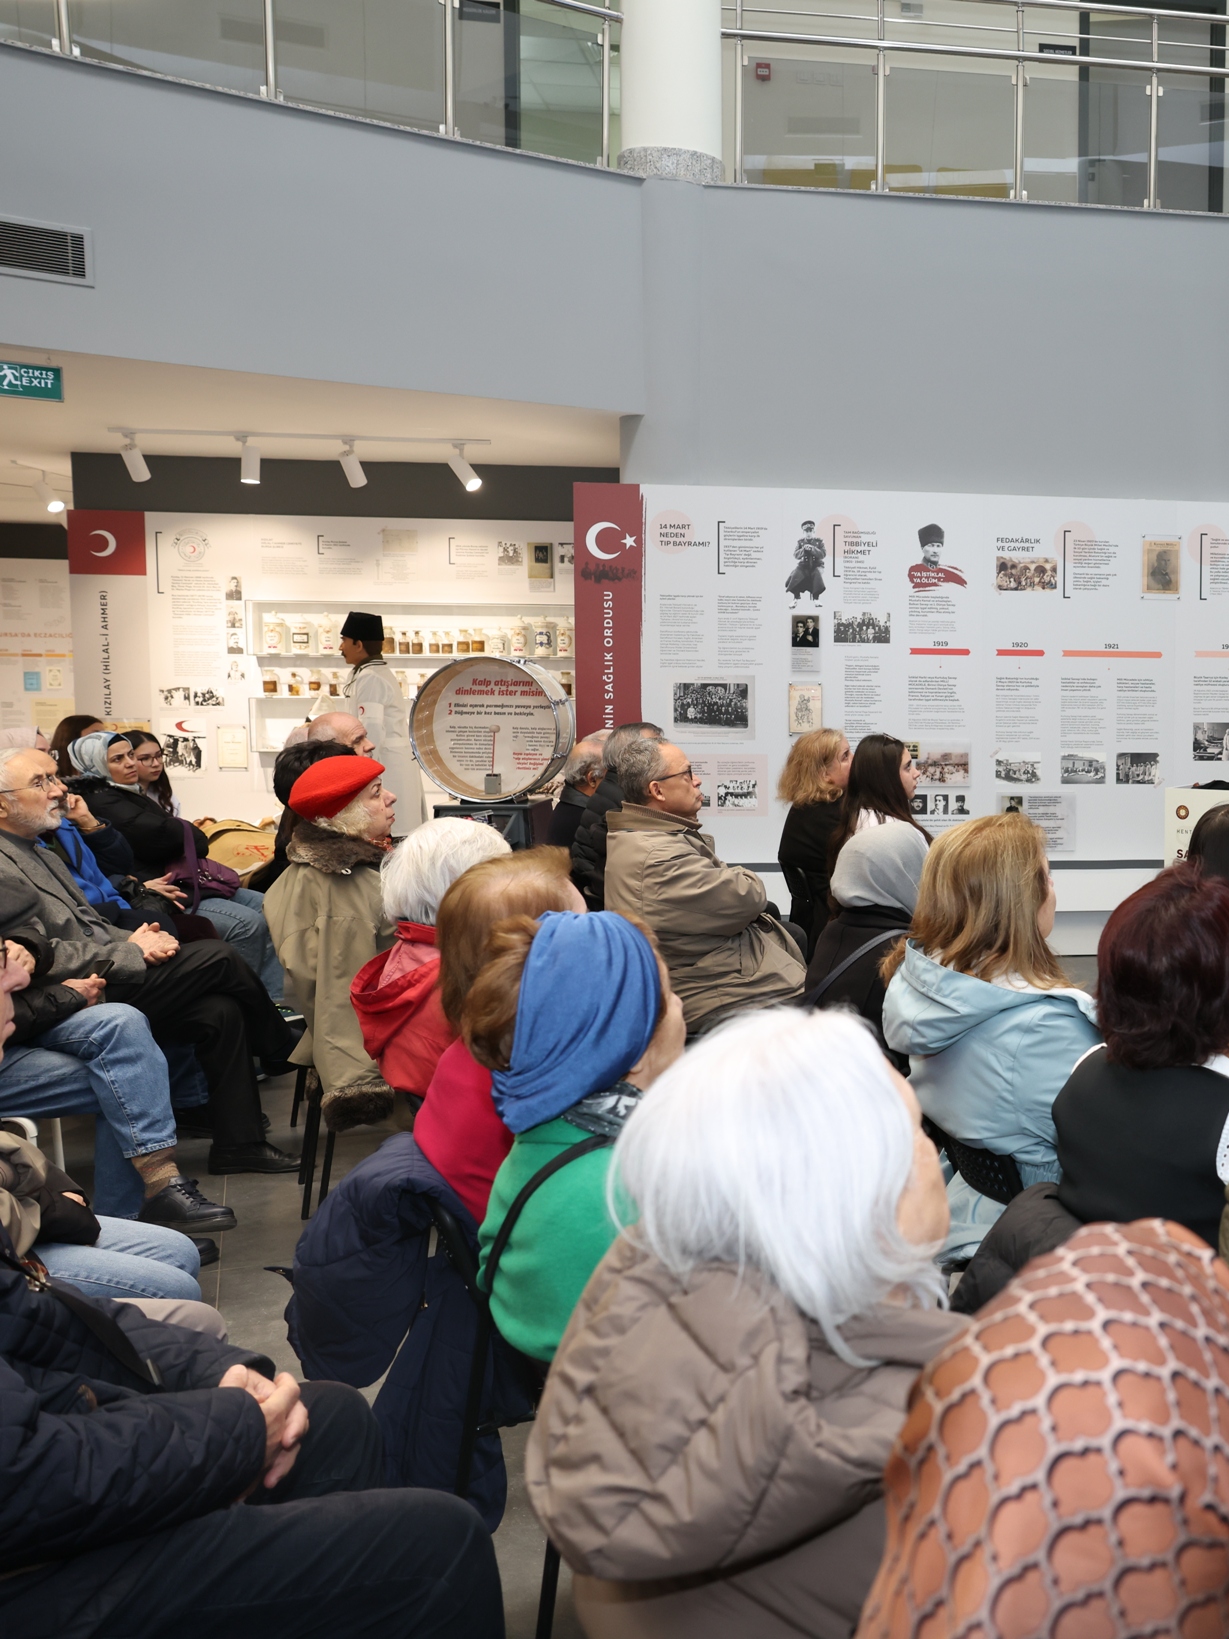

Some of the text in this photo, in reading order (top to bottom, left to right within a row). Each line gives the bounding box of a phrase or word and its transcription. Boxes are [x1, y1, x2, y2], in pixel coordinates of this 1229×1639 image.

[20, 368, 54, 380] ÇIKIŞ
[22, 377, 54, 388] EXIT
[98, 590, 109, 631] AHMER)
[603, 591, 614, 732] NİN SAĞLIK ORDUSU
[472, 678, 534, 688] Kalp atışlarını
[104, 678, 112, 716] KIZILAY
[455, 687, 495, 696] dinlemek
[498, 688, 518, 696] ister
